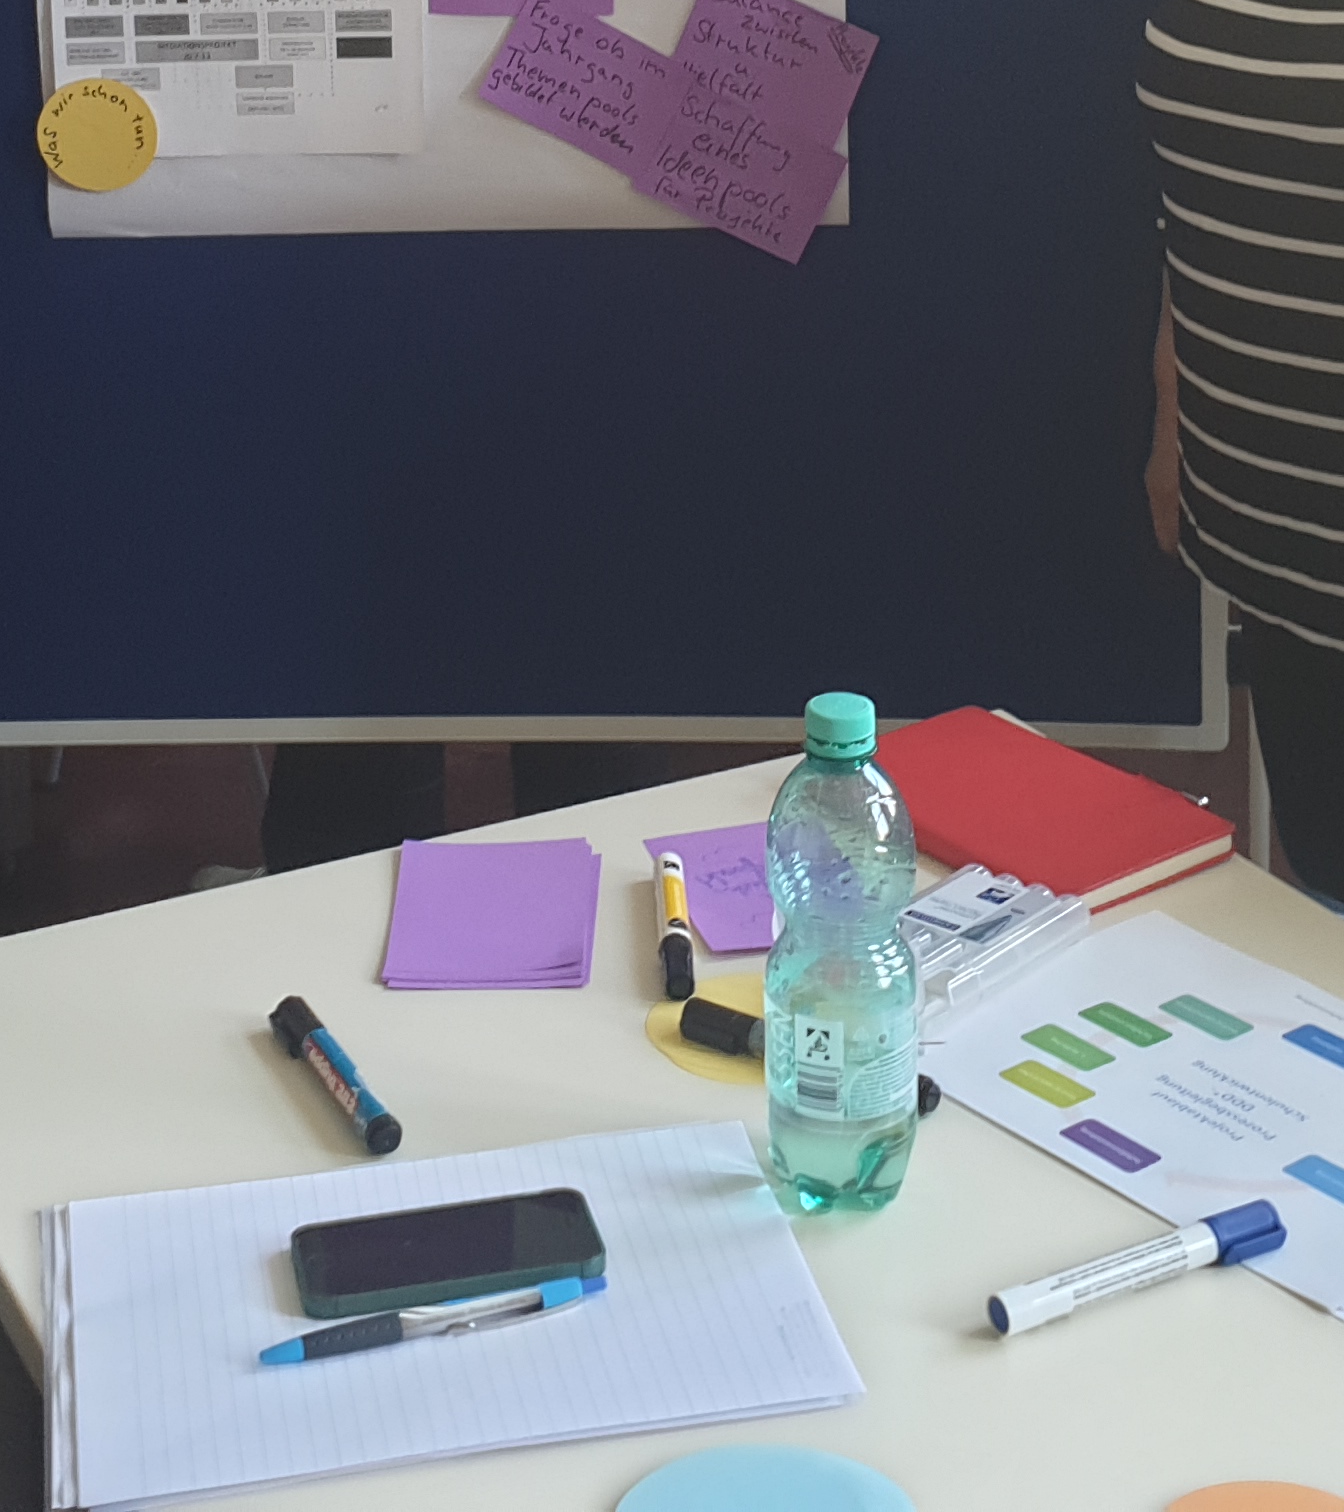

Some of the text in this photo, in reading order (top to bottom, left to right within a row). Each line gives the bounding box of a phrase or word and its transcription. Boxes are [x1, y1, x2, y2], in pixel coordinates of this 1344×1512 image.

[522, 22, 634, 101] Jahrgang
[595, 37, 625, 60] ob
[638, 58, 666, 79] im
[693, 18, 804, 68] Struktur
[52, 92, 74, 117] wir
[82, 84, 128, 113] schon
[43, 127, 64, 168] Was
[558, 106, 634, 154] werden
[680, 94, 792, 172] Schaffung
[692, 132, 751, 170] eines
